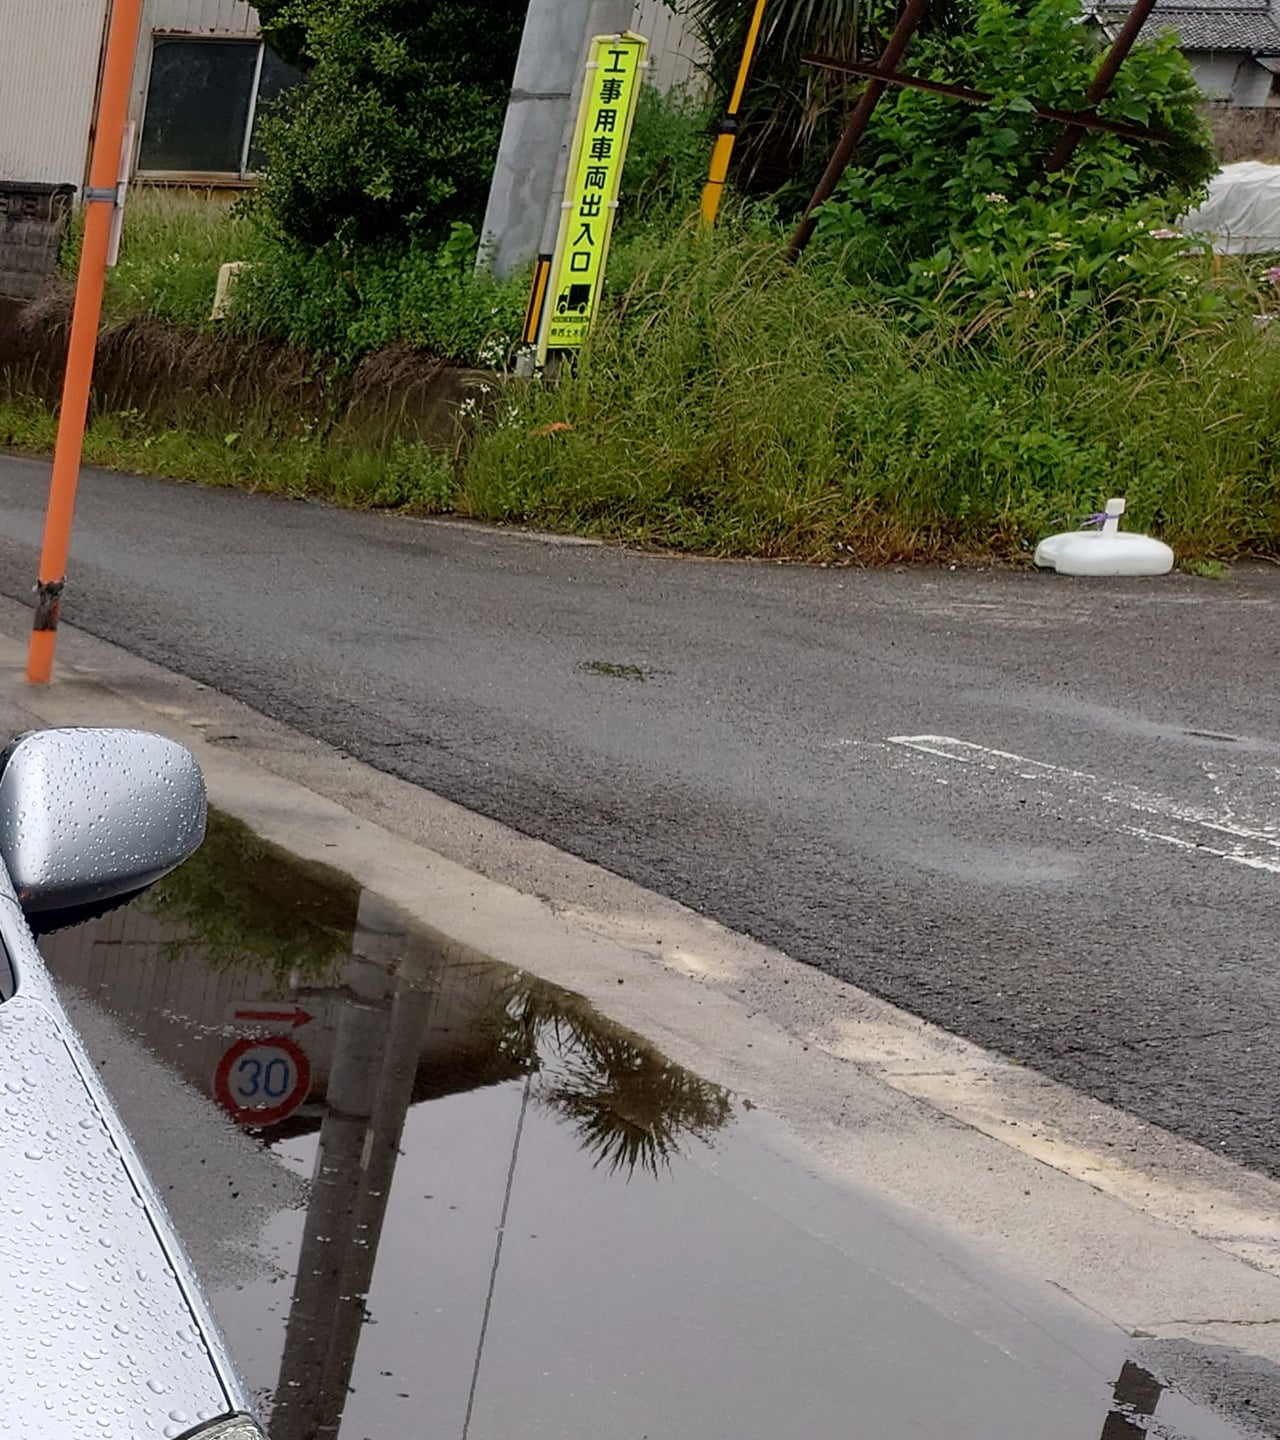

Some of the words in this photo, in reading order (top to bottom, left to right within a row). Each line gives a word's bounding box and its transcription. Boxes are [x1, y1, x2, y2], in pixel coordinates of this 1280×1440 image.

[569, 50, 629, 272] 工事用車両出入口
